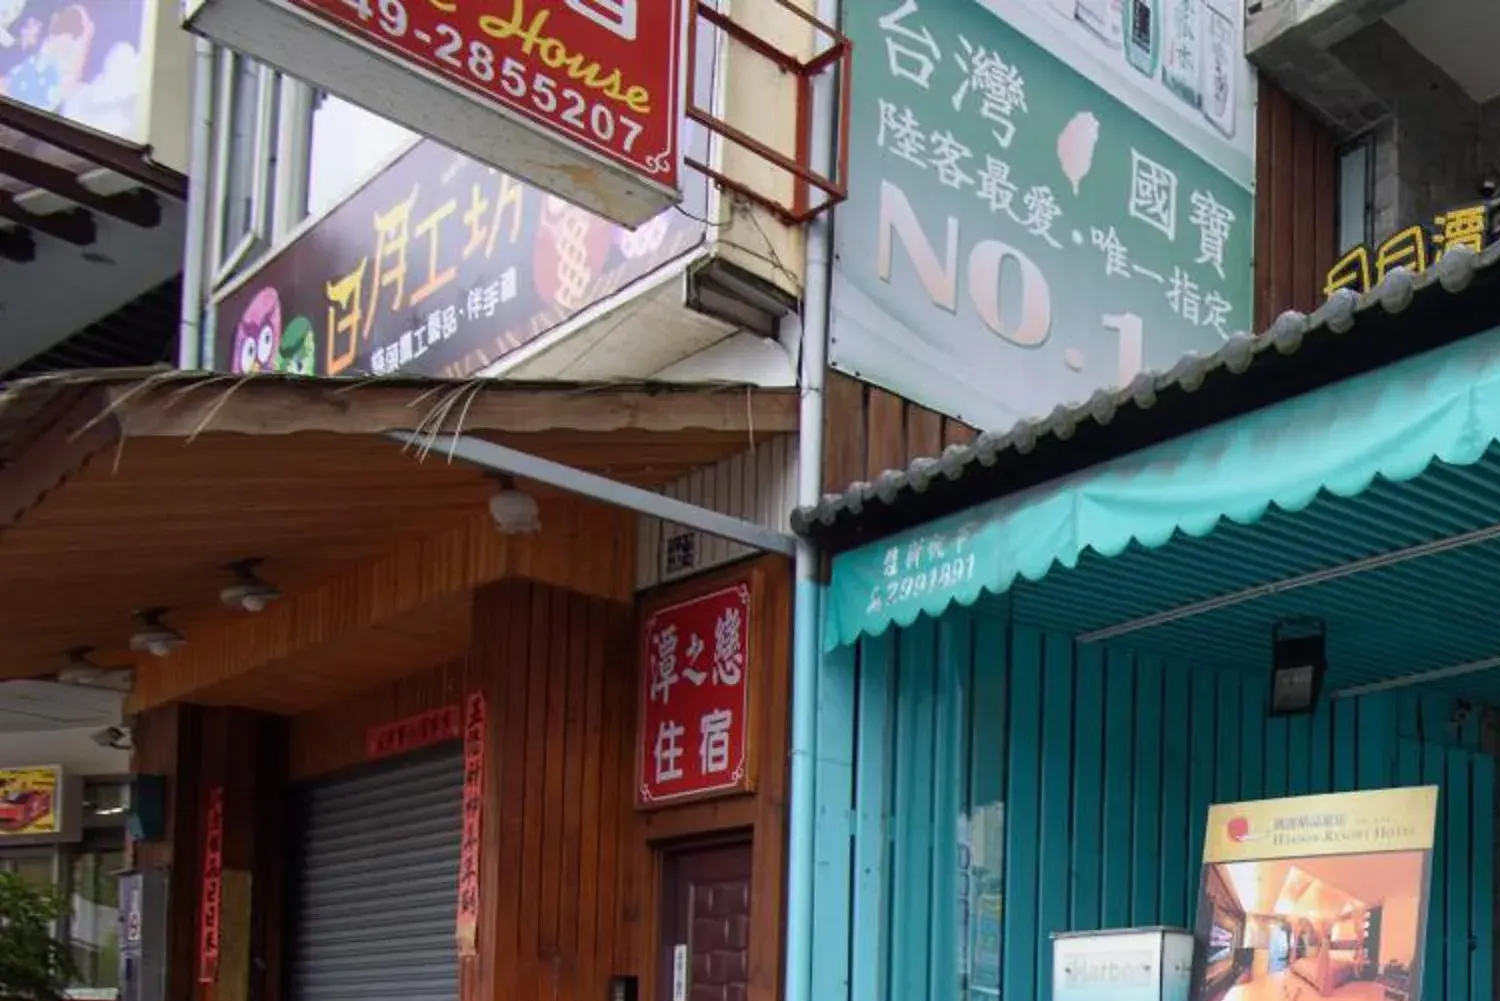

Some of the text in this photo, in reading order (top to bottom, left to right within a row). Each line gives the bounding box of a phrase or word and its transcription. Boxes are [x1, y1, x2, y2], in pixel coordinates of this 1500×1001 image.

[1128, 148, 1235, 280] 國寶
[650, 607, 743, 704] 潭之戀
[654, 707, 733, 784] 住宿
